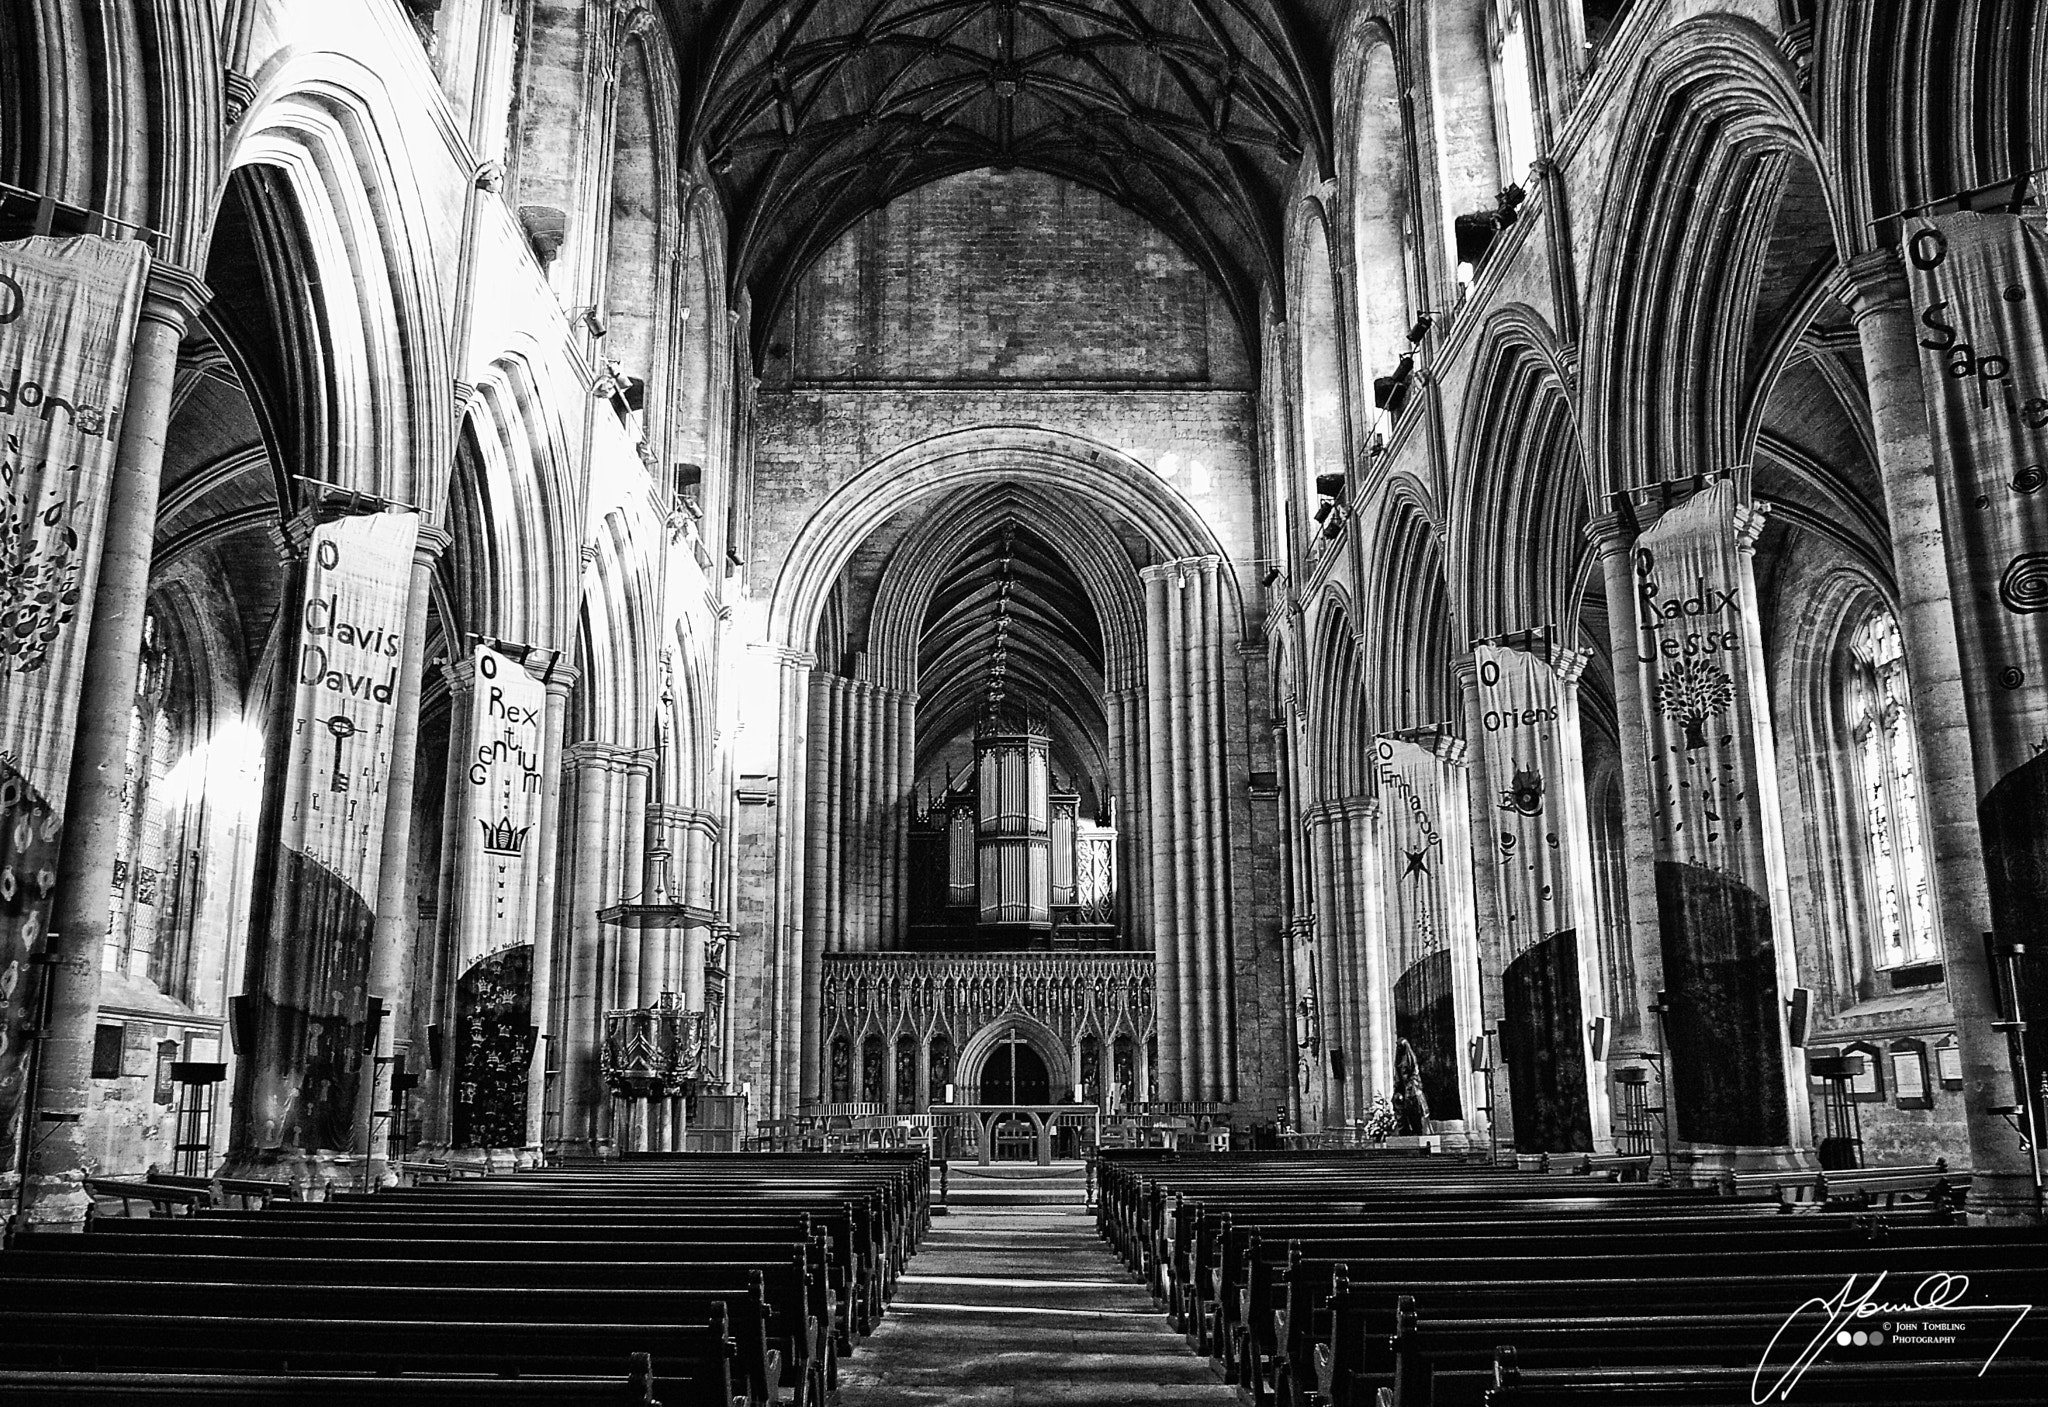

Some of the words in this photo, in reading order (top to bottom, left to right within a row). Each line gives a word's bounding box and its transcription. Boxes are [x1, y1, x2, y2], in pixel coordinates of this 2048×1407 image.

[1909, 228, 1948, 271] O
[0, 368, 119, 442] donai
[317, 540, 339, 571] O
[1636, 547, 1654, 578] O
[1638, 577, 1741, 623] Radix
[305, 594, 399, 657] Clavis
[1638, 623, 1740, 662] Jesse
[300, 644, 397, 705] David
[480, 655, 497, 679] O
[1480, 660, 1500, 687] O
[489, 686, 538, 727] Rex
[469, 727, 542, 795] Gentium
[1379, 742, 1393, 760] O
[1380, 762, 1444, 865] Emmanuel
